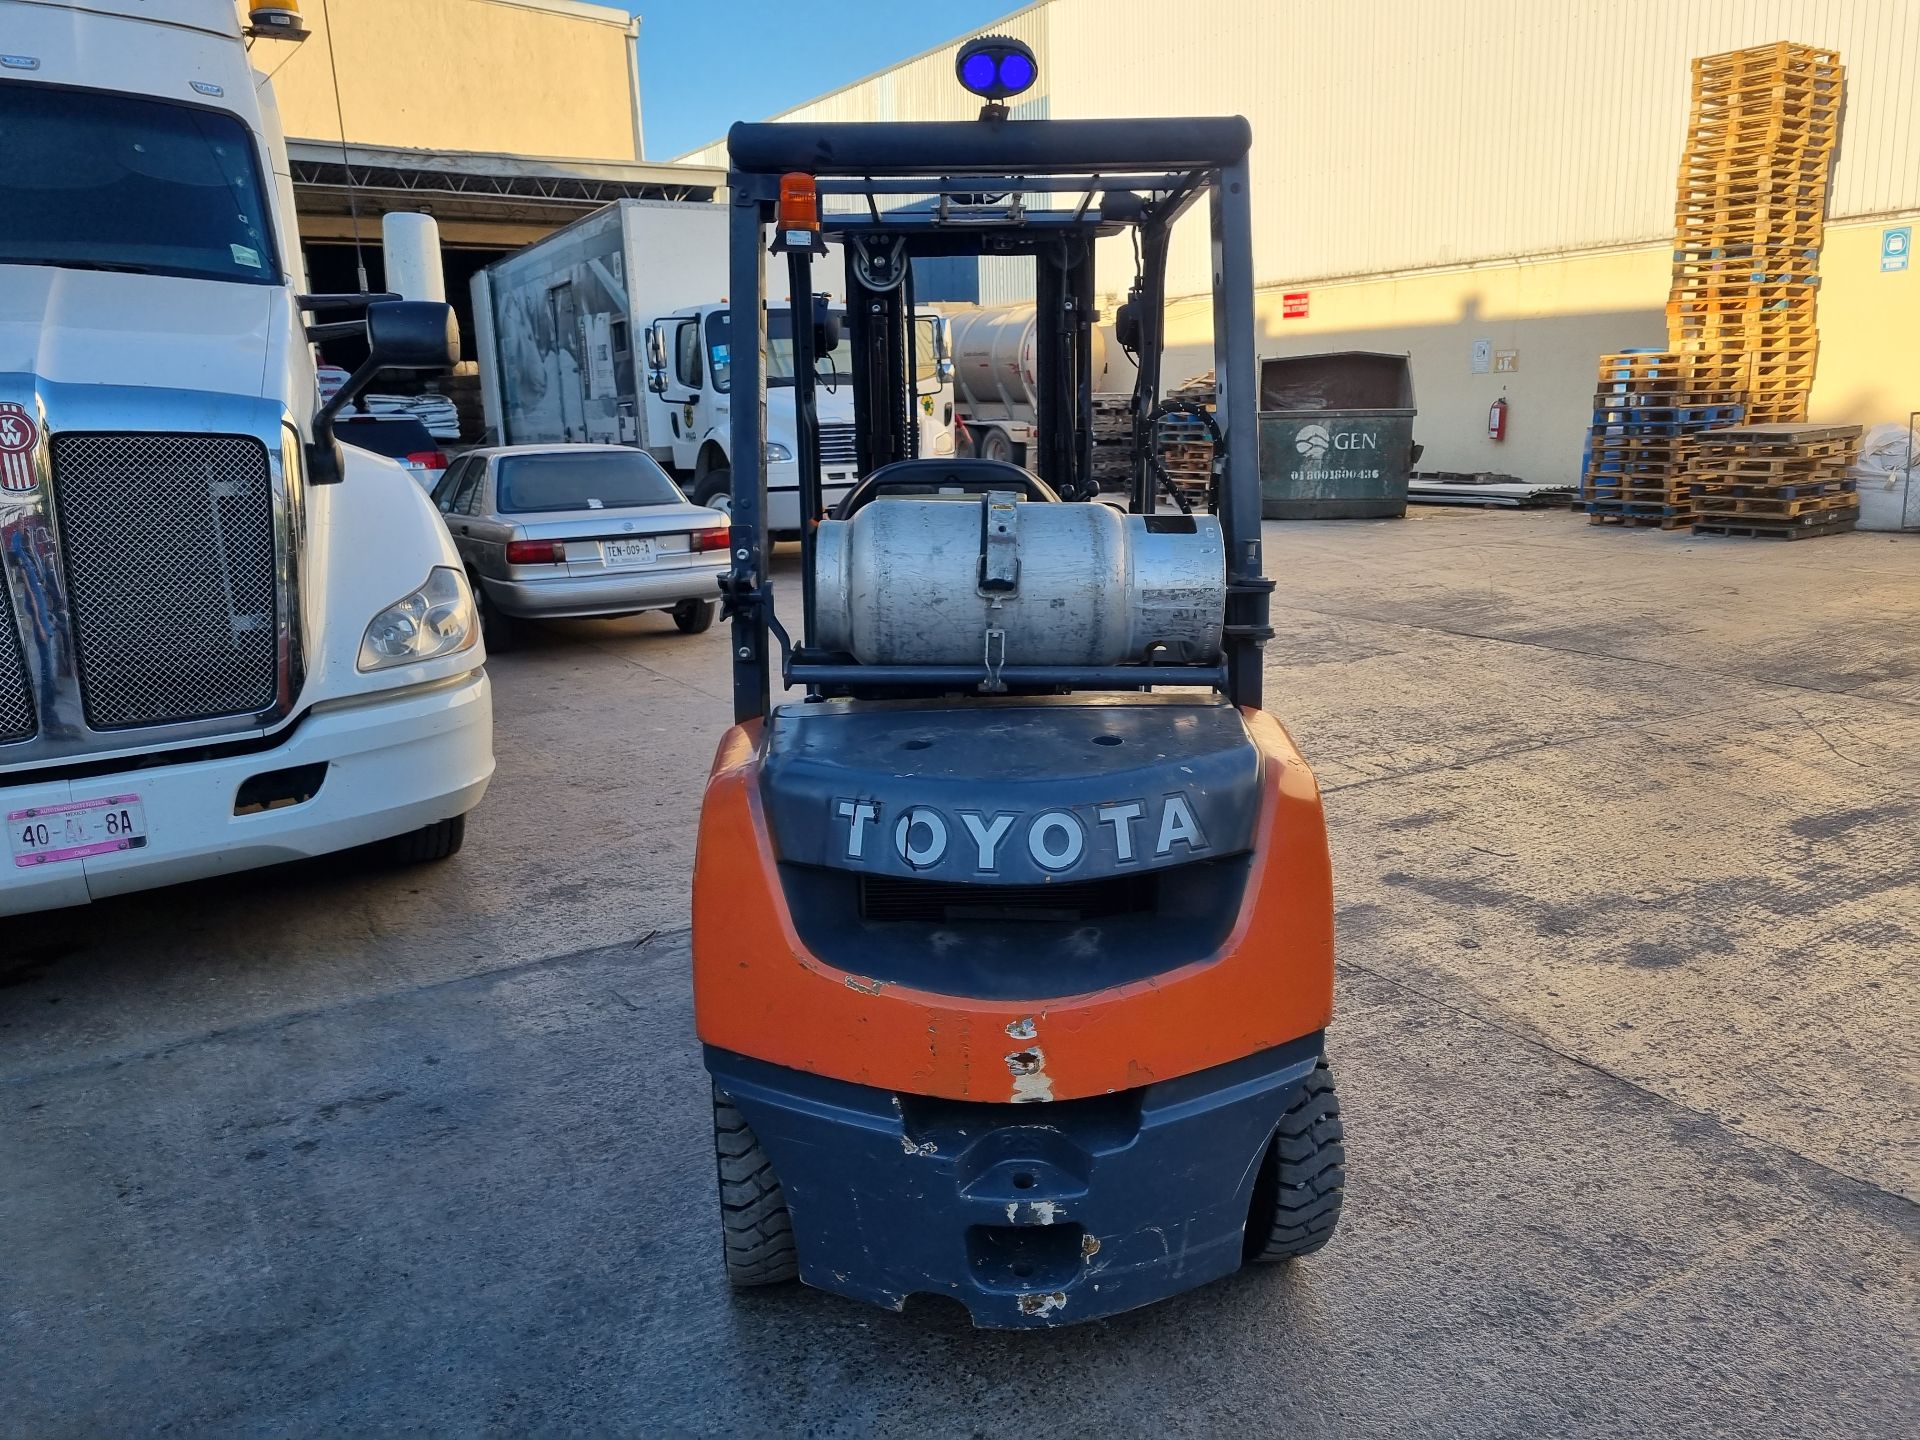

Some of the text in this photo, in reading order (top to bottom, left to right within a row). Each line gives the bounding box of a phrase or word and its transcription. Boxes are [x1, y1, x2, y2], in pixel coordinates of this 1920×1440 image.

[2, 419, 17, 432] K
[0, 432, 21, 446] W
[1334, 432, 1377, 449] GEN
[838, 796, 1207, 869] TOYOTA
